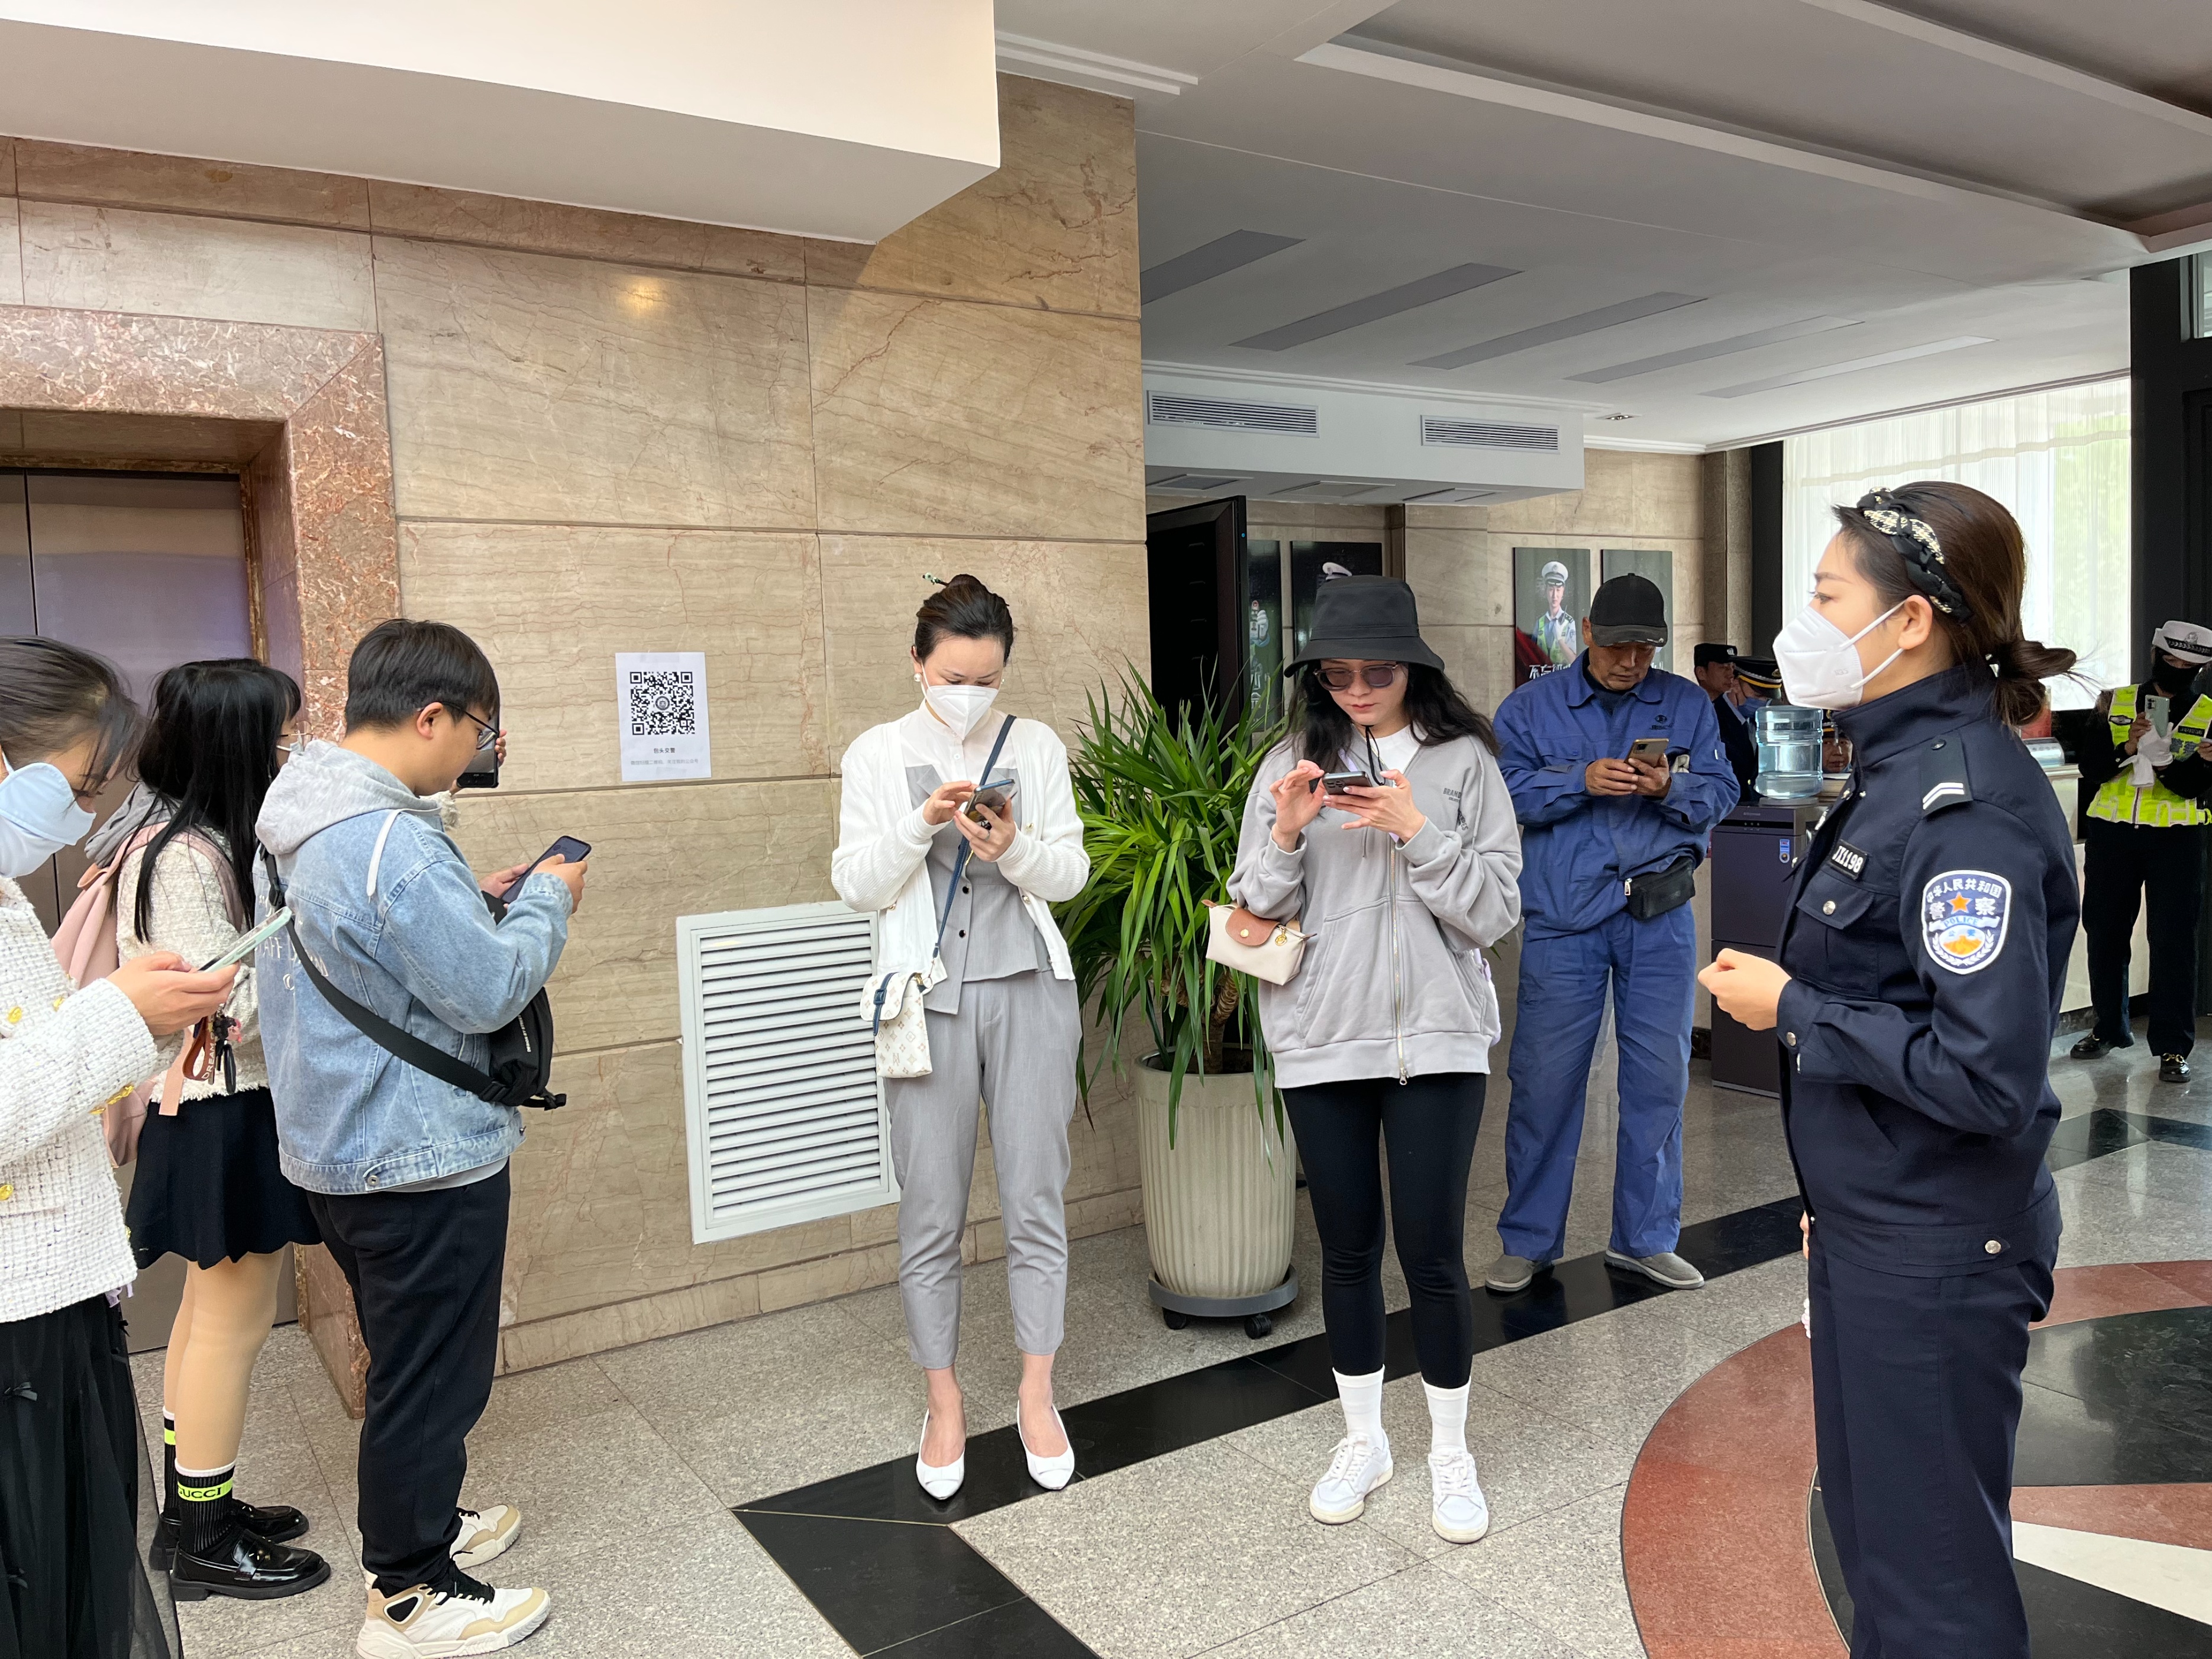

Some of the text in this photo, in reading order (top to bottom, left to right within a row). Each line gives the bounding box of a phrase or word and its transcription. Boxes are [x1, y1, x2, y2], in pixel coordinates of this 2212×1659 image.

[1832, 845, 1864, 873] JX1198
[1926, 878, 2003, 903] 中华人民共和国
[1943, 916, 1979, 928] POLICE
